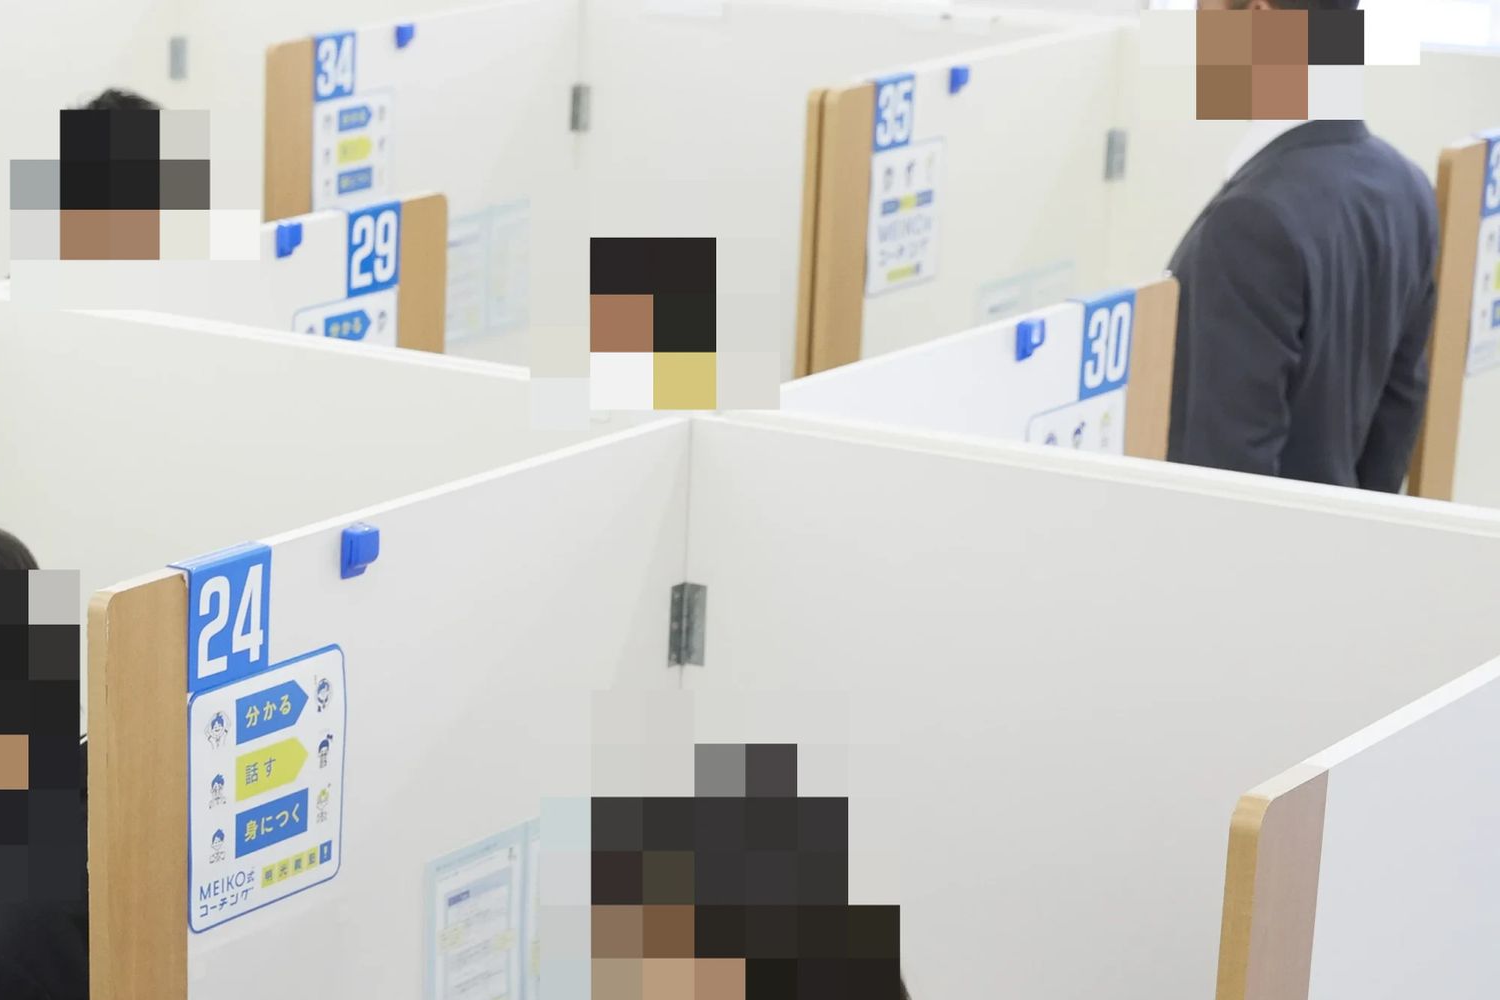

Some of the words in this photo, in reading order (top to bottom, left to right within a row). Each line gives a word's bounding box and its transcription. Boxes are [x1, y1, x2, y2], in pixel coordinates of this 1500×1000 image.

[316, 34, 354, 97] 34
[876, 79, 912, 148] 35
[1485, 140, 1500, 209] 3
[350, 209, 398, 290] 29
[1084, 301, 1132, 389] 30
[197, 563, 263, 680] 24
[245, 694, 292, 728] 分かる
[245, 757, 276, 785] 話す
[244, 803, 300, 842] 身につく
[200, 887, 254, 918] コーチング
